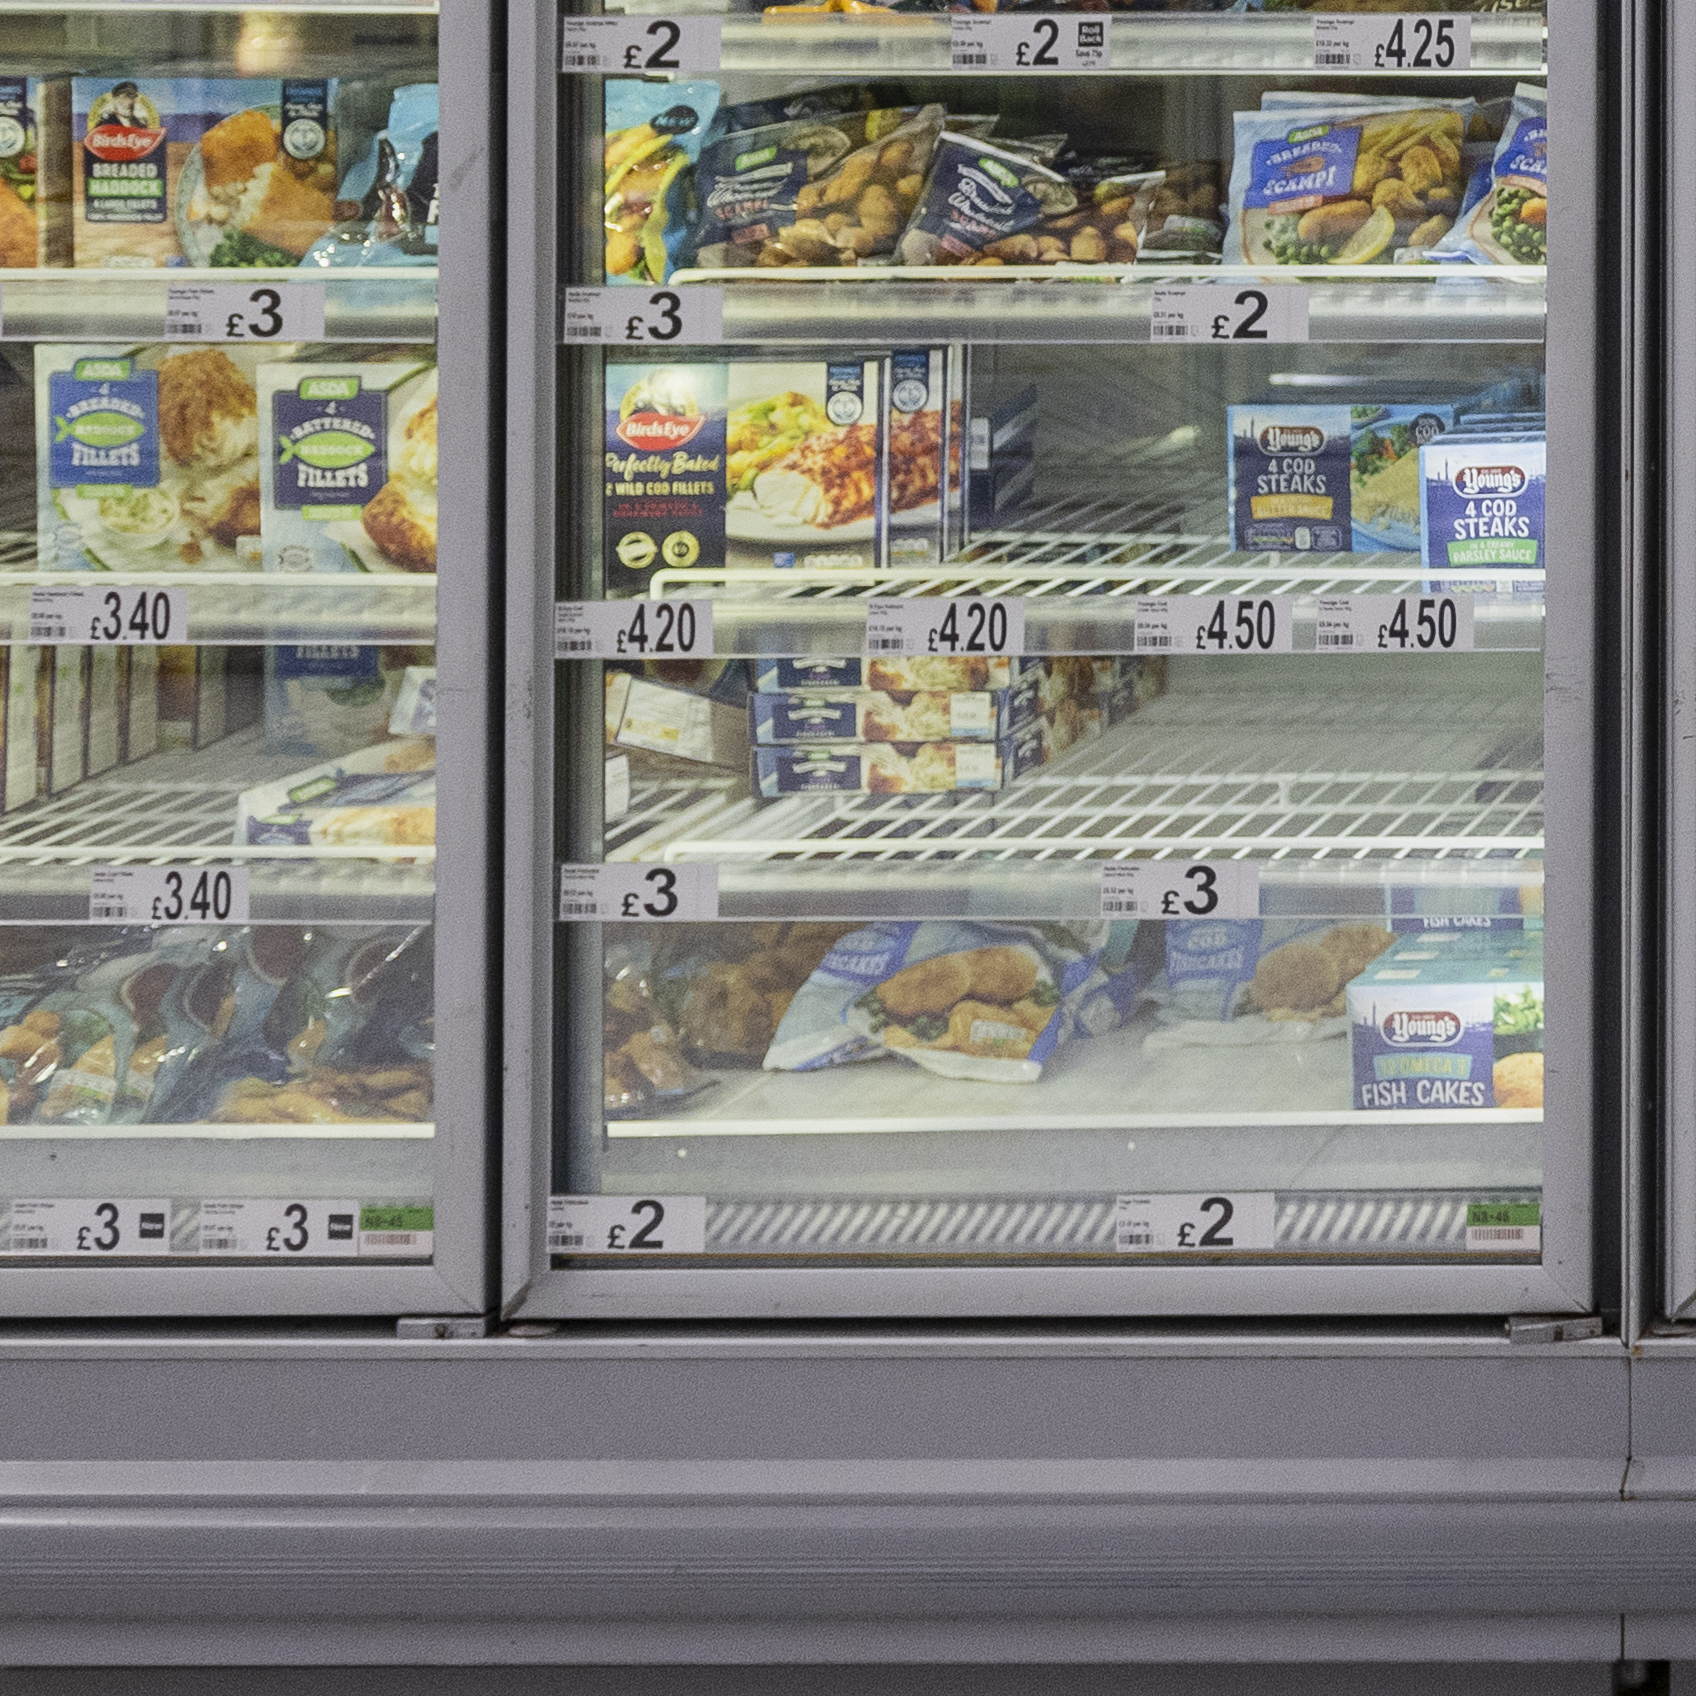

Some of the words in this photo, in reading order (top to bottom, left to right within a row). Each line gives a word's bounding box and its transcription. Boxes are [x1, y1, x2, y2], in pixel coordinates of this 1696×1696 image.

[623, 20, 681, 69] £2
[1014, 19, 1059, 66] £2
[1374, 18, 1455, 68] £4.25
[93, 132, 153, 150] BirdsEye
[93, 163, 157, 179] BREADED
[1263, 164, 1337, 197] SCAMPI
[226, 289, 282, 337] £3
[625, 291, 682, 340] £3
[1210, 291, 1268, 340] £2
[626, 415, 689, 437] BirdsEye
[1267, 431, 1320, 453] Young's
[71, 442, 140, 467] FILLETS
[298, 463, 369, 487] FILLETS
[671, 453, 719, 474] Baked
[1268, 459, 1279, 474] 4
[1283, 459, 1315, 474] COD
[615, 482, 641, 495] WILD
[644, 482, 670, 495] COD
[672, 480, 714, 494] FILLETS
[1257, 474, 1326, 494] STEAKS
[1463, 469, 1521, 492] Young's
[1453, 517, 1530, 540] STEAKS
[1465, 502, 1477, 517] 4
[1481, 500, 1517, 517] COD
[1498, 547, 1532, 561] SAUCE
[91, 592, 170, 640] £3.40
[616, 604, 696, 654] £4.20
[927, 603, 1007, 652] £4.20
[1196, 600, 1275, 649] £4.50
[1377, 599, 1457, 649] £4.50
[152, 872, 231, 920] £3.40
[622, 868, 679, 917] £3
[1161, 865, 1219, 915] £3
[1392, 1012, 1456, 1041] Young's
[1362, 1082, 1407, 1107] FISH
[1416, 1080, 1486, 1107] CAKES
[77, 1203, 120, 1251] £3
[266, 1204, 309, 1251] £3
[608, 1200, 664, 1250] £2
[1177, 1197, 1234, 1247] £2
